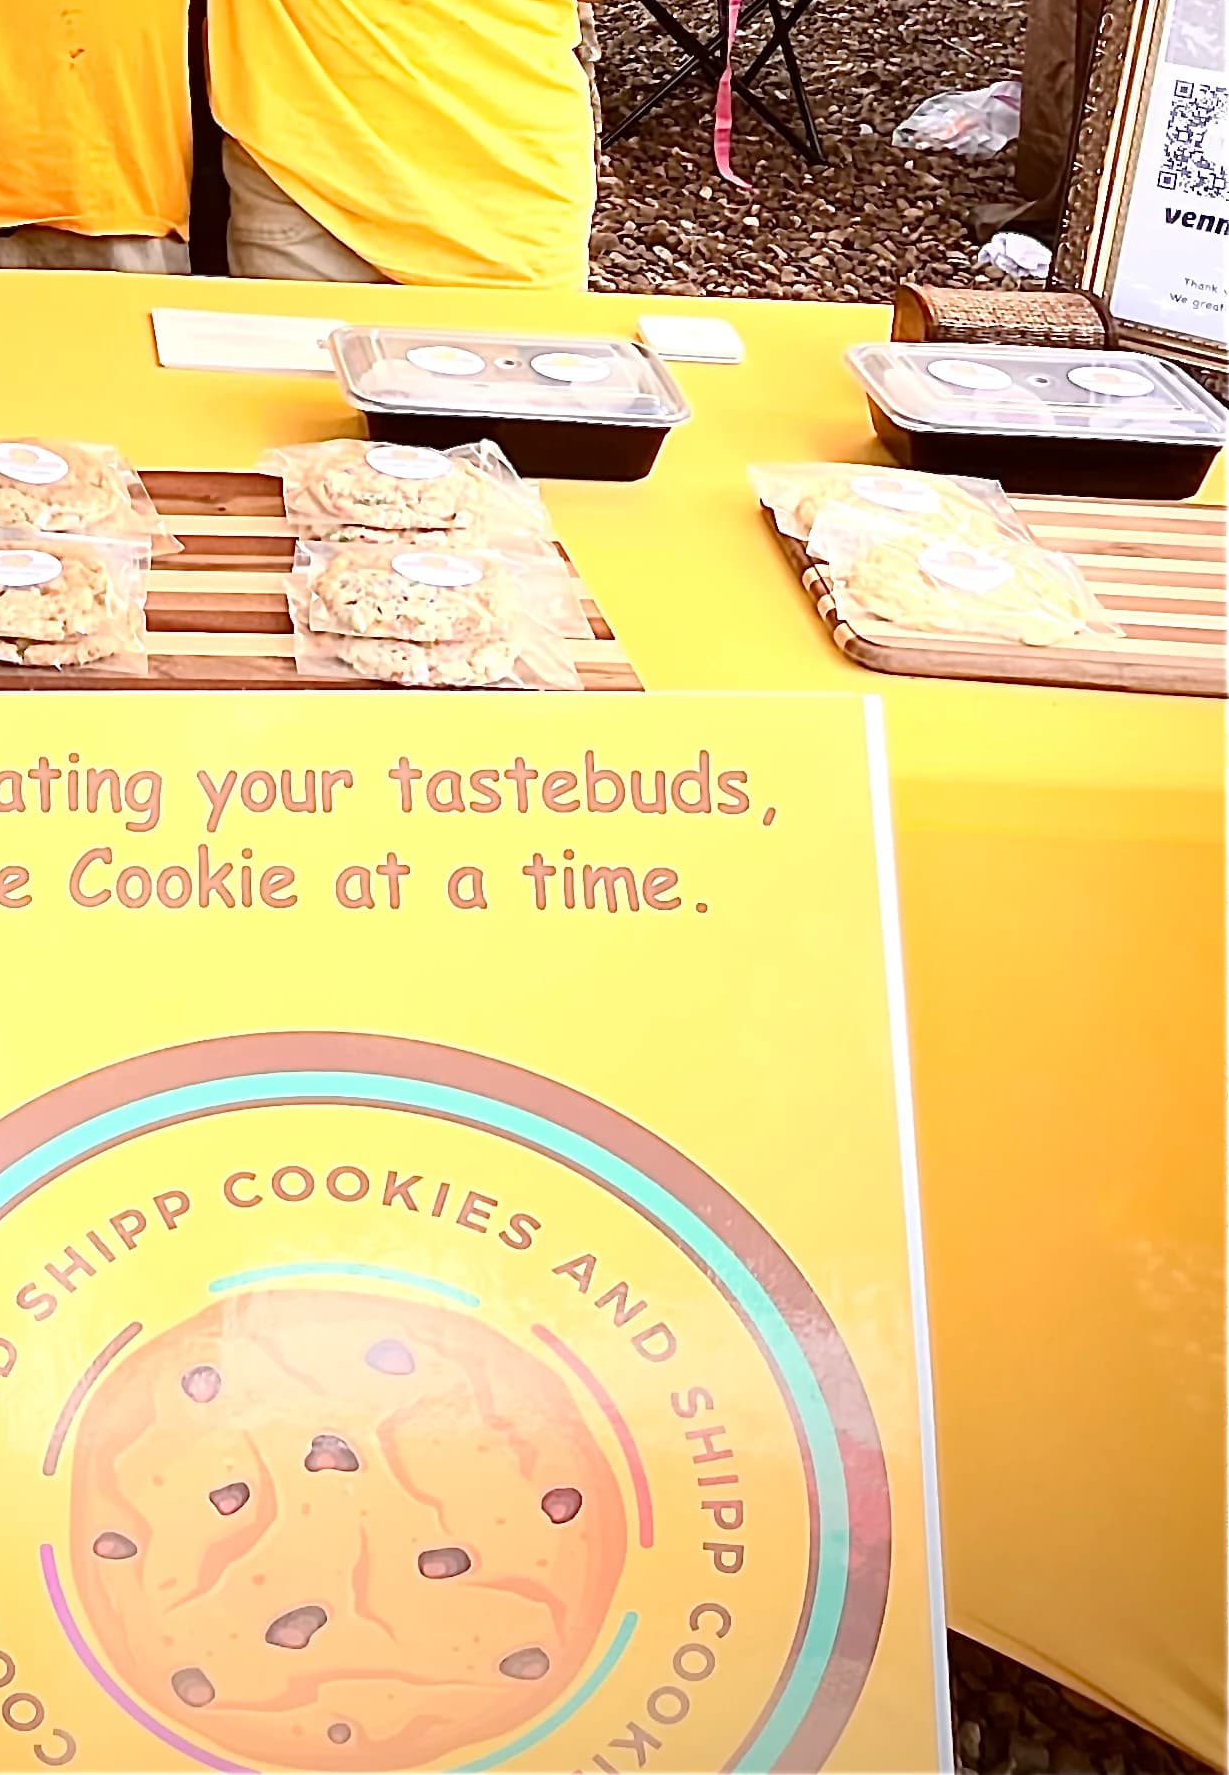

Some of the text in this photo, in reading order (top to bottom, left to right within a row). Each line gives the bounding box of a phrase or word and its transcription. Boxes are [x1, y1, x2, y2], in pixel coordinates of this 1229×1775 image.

[1169, 292, 1188, 304] We
[1184, 277, 1218, 294] Thank
[196, 769, 354, 833] your
[387, 749, 777, 827] tastebuds,
[68, 843, 299, 909] Cookie
[335, 851, 411, 910] at
[447, 865, 488, 910] a
[521, 848, 709, 913] time.
[222, 1164, 542, 1251] COOKIES
[15, 1189, 191, 1322] SHIPP
[551, 1252, 678, 1363] AND
[670, 1385, 745, 1574] SHIPP
[573, 1602, 732, 1773] COOKI
